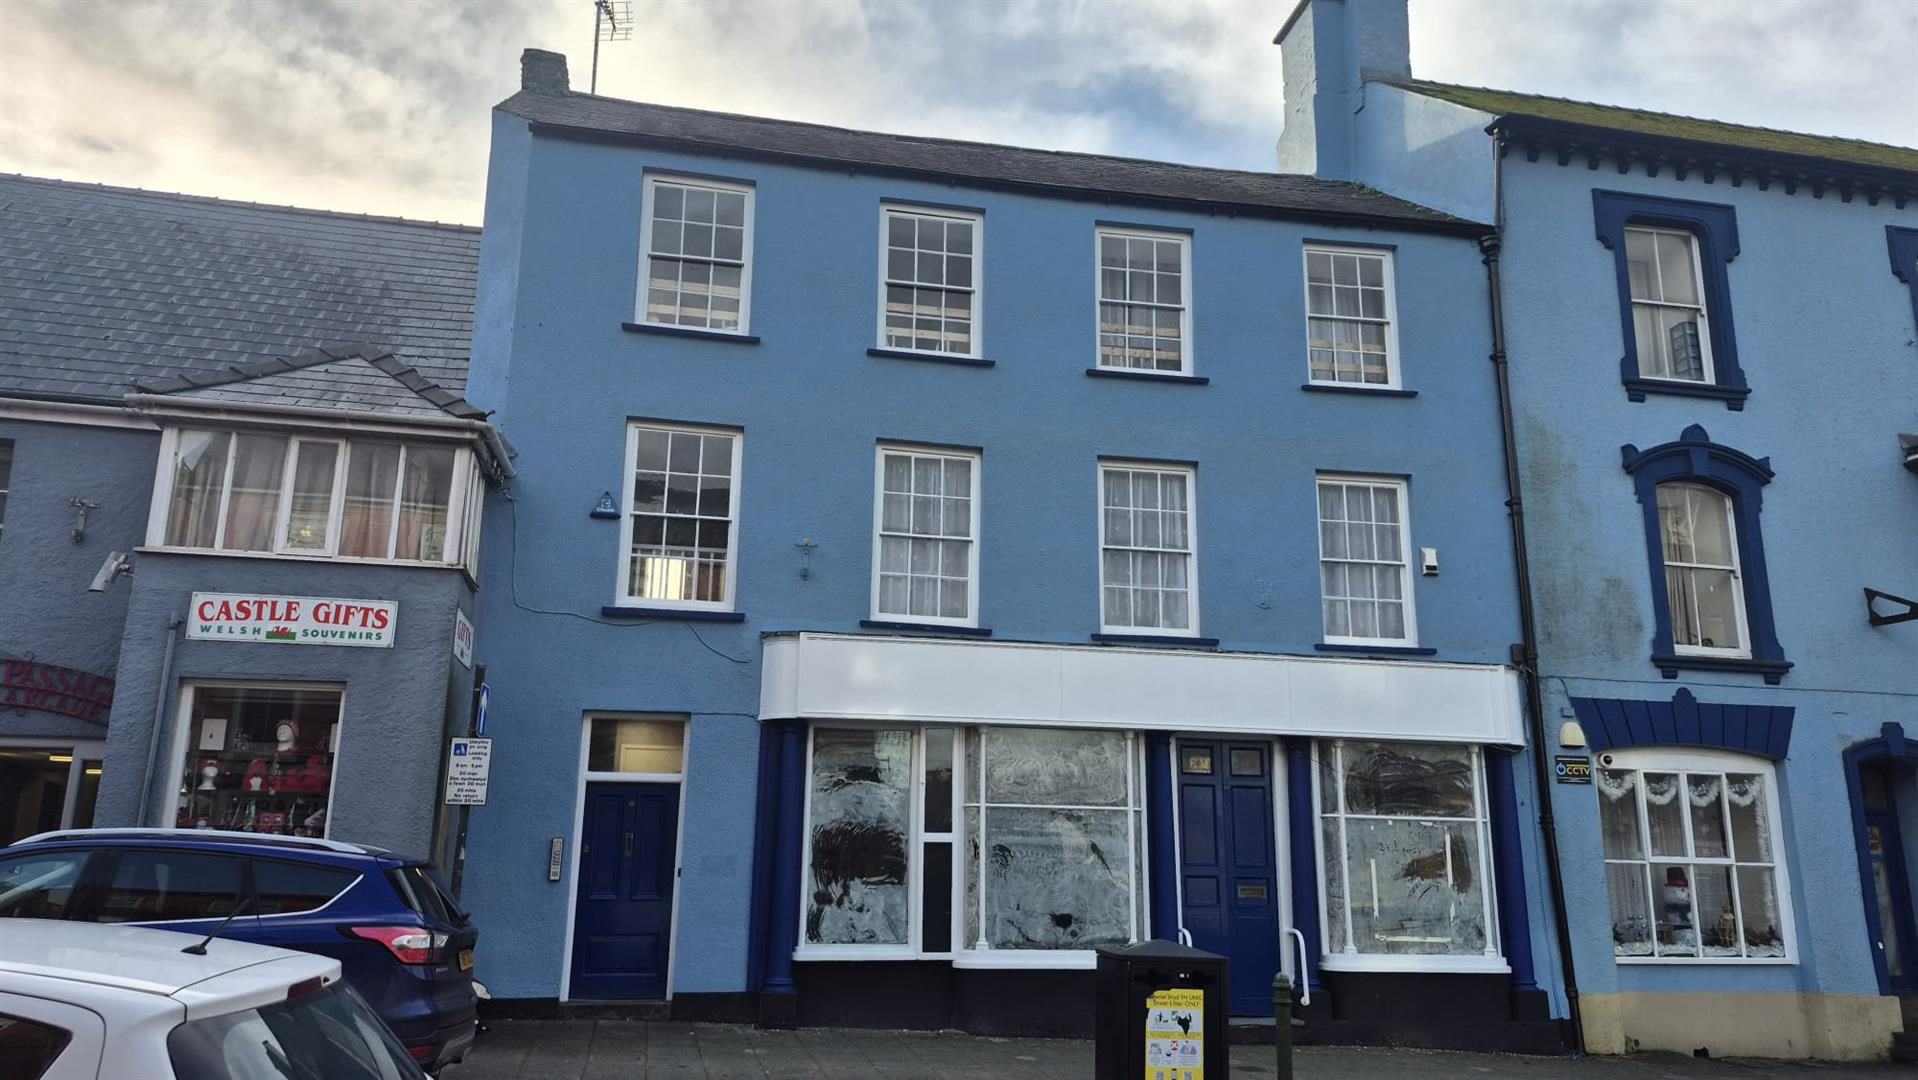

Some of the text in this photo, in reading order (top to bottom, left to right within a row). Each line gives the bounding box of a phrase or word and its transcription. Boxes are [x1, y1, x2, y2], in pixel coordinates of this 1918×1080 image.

[198, 600, 389, 629] CASTLE GIFTS
[200, 625, 383, 640] WELSH SOUVENIRS
[1566, 766, 1590, 776] CCTV
